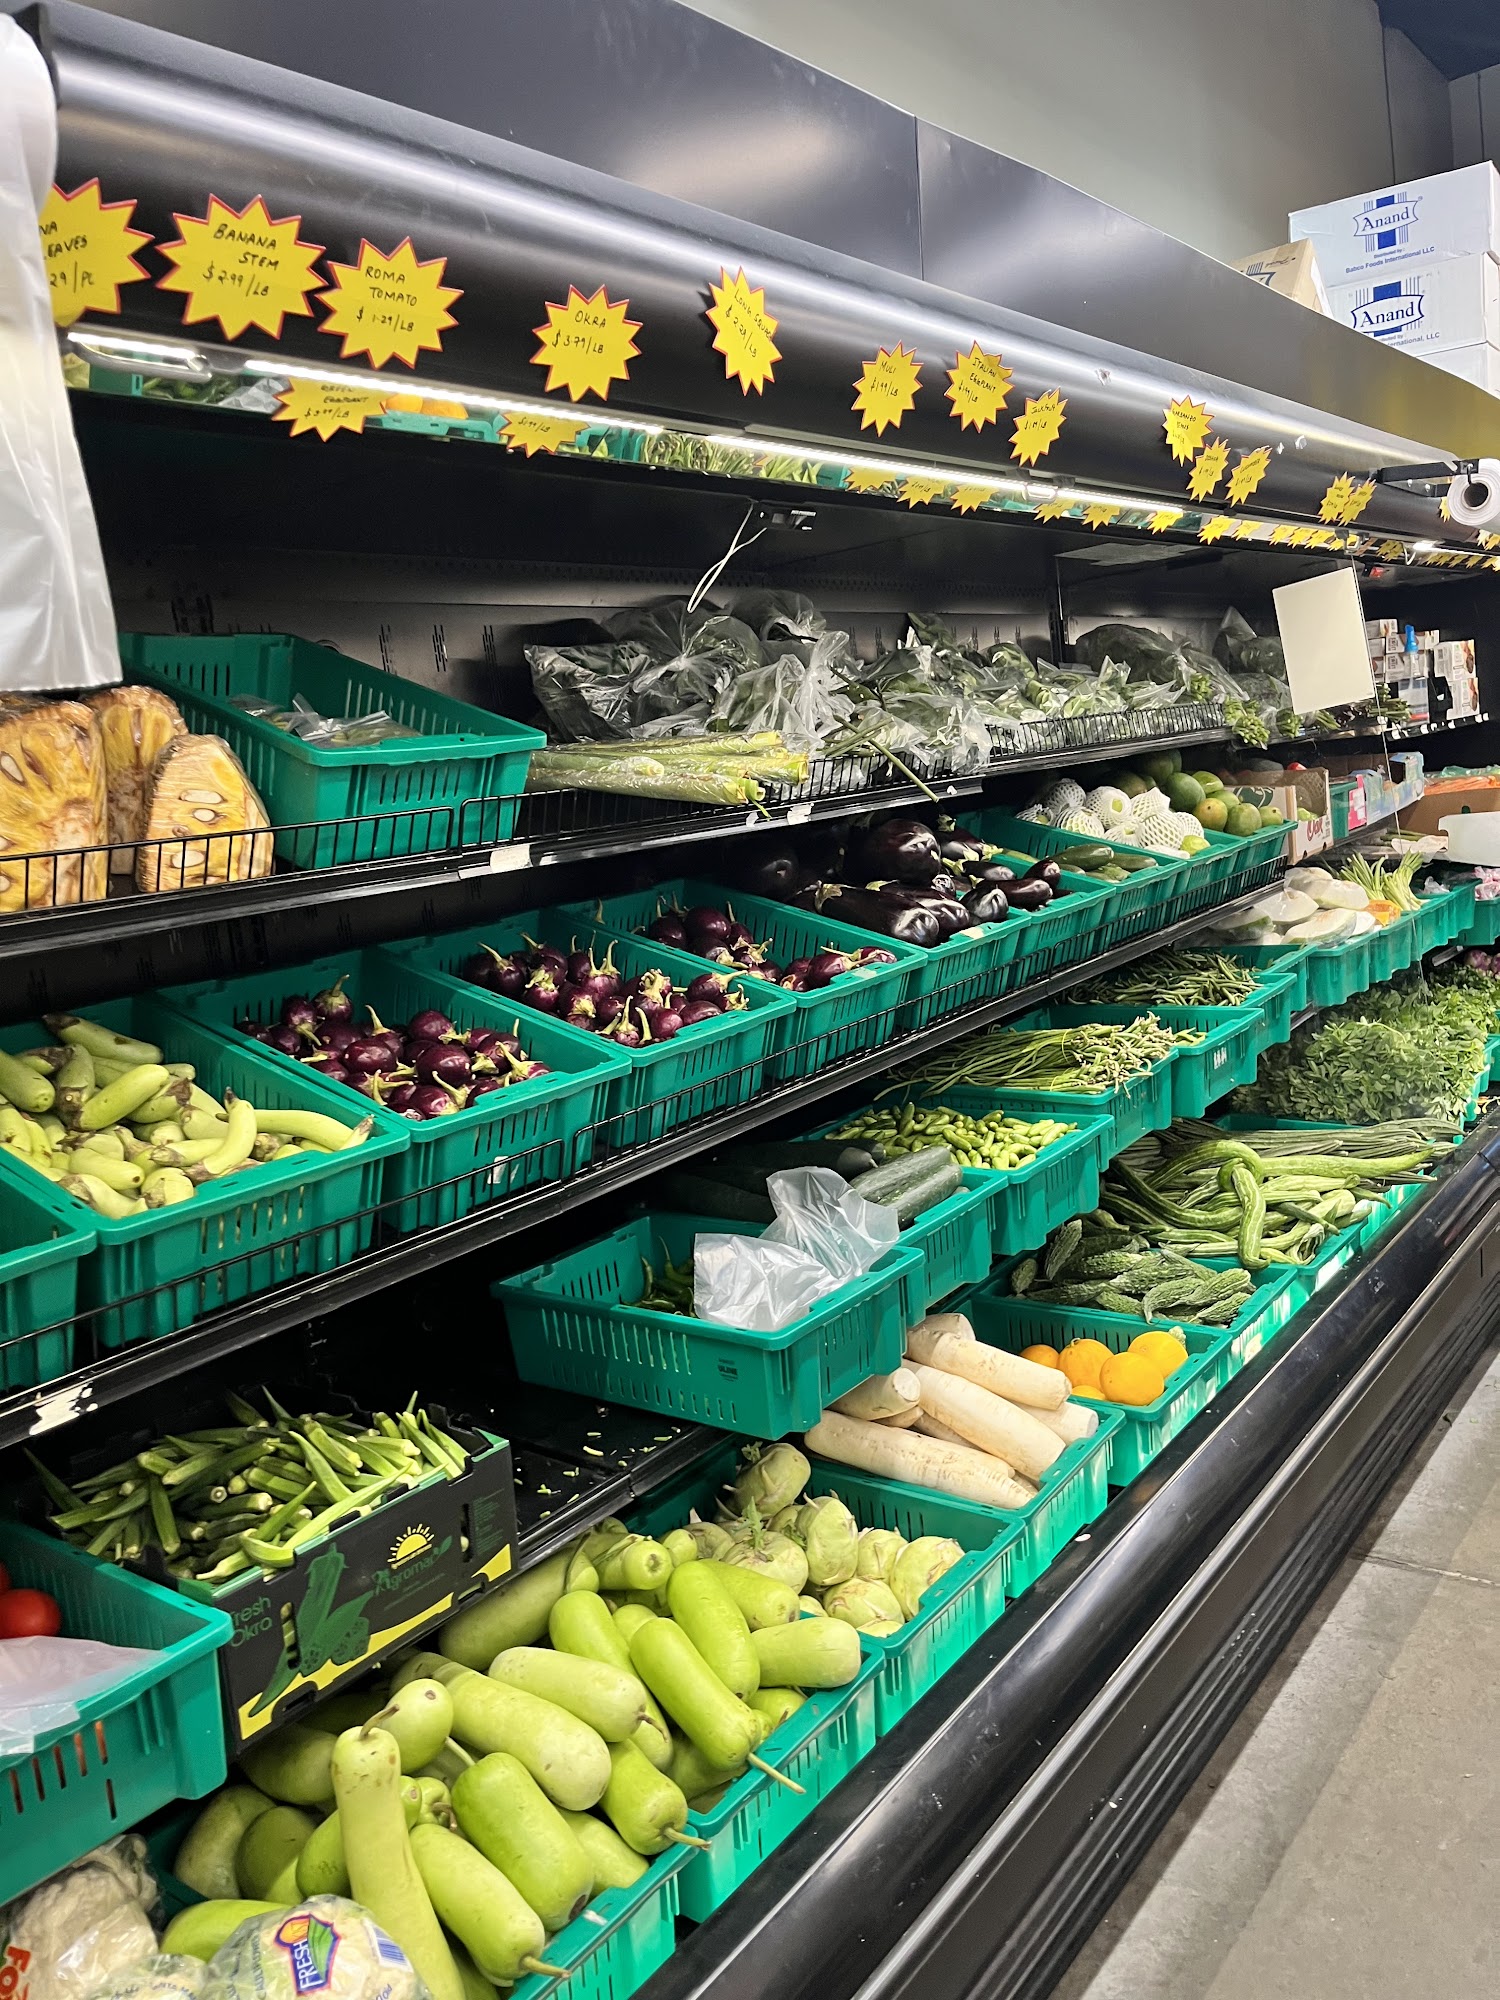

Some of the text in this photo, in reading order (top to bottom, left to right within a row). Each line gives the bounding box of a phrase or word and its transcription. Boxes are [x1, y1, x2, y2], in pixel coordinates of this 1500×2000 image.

[1361, 207, 1410, 232] Anand
[213, 223, 277, 250] BANANA
[44, 235, 88, 260] EAVES
[1366, 259, 1384, 269] Foods
[1385, 249, 1422, 264] International
[1422, 246, 1435, 254] LLC
[238, 251, 280, 271] STEM
[365, 265, 406, 284] ROMA
[368, 286, 418, 307] TOMATO
[574, 310, 606, 328] OKRA
[1360, 301, 1415, 328] Anand
[1426, 331, 1440, 340] LLC
[880, 361, 896, 374] MULI
[972, 357, 997, 378] ITALIAN
[293, 1938, 326, 1991] FRESH
